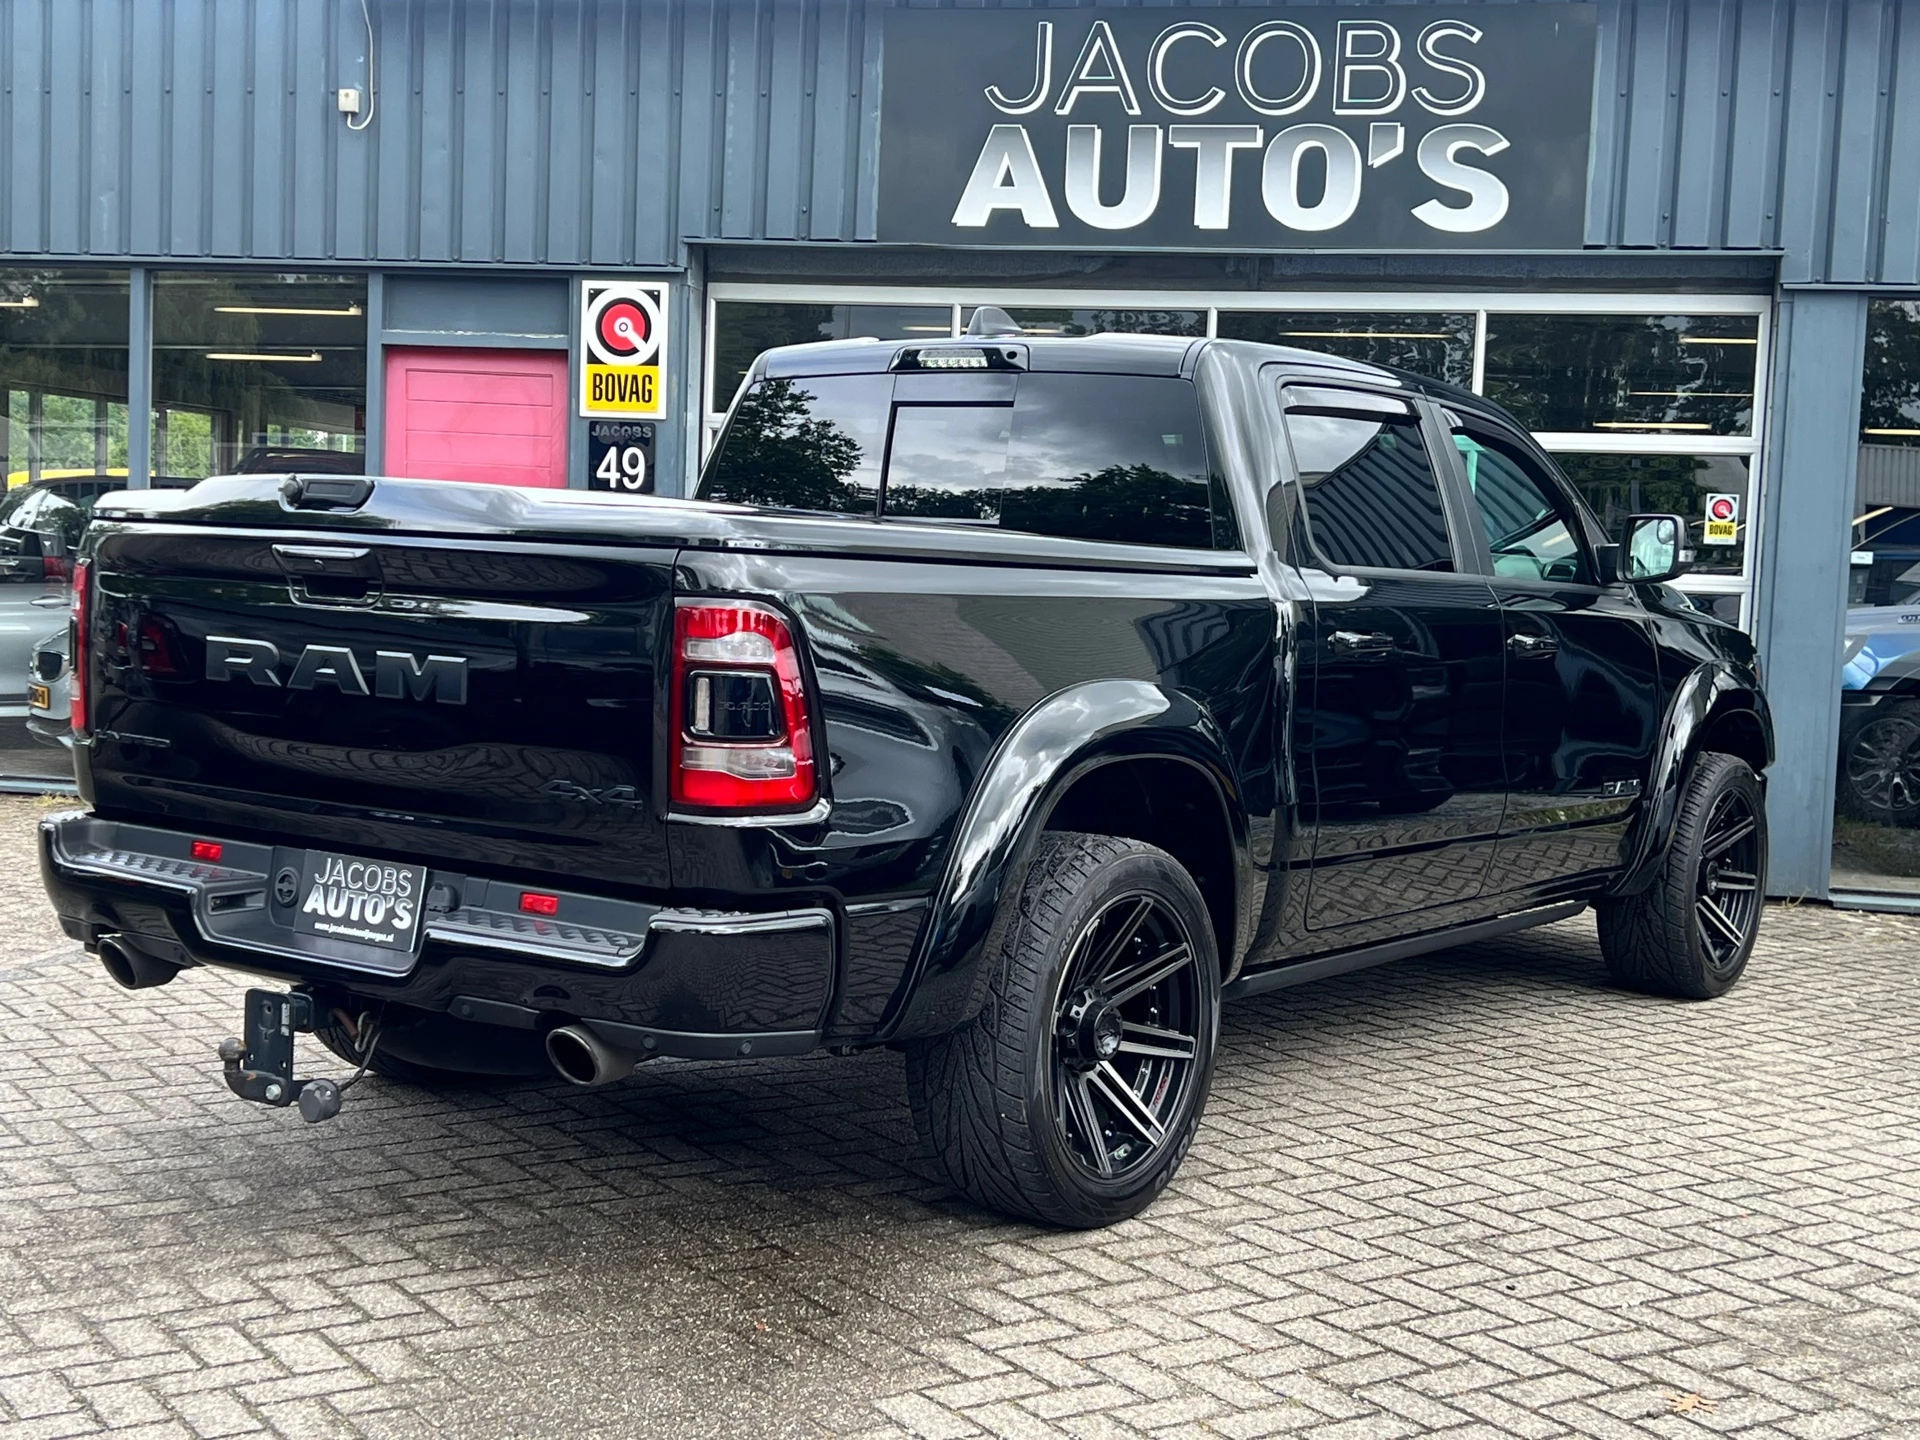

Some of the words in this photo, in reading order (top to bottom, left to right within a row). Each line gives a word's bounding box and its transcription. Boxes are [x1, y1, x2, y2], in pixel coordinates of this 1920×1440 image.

[984, 20, 1485, 115] JACOBS
[951, 122, 1510, 232] AUTO'S
[592, 373, 653, 403] BOVAG
[591, 424, 652, 439] JACOBS
[596, 446, 646, 490] 49
[1709, 524, 1733, 535] BOVAG
[206, 635, 467, 705] RAM
[314, 857, 413, 897] JACOBS
[302, 884, 414, 930] AUTO'S
